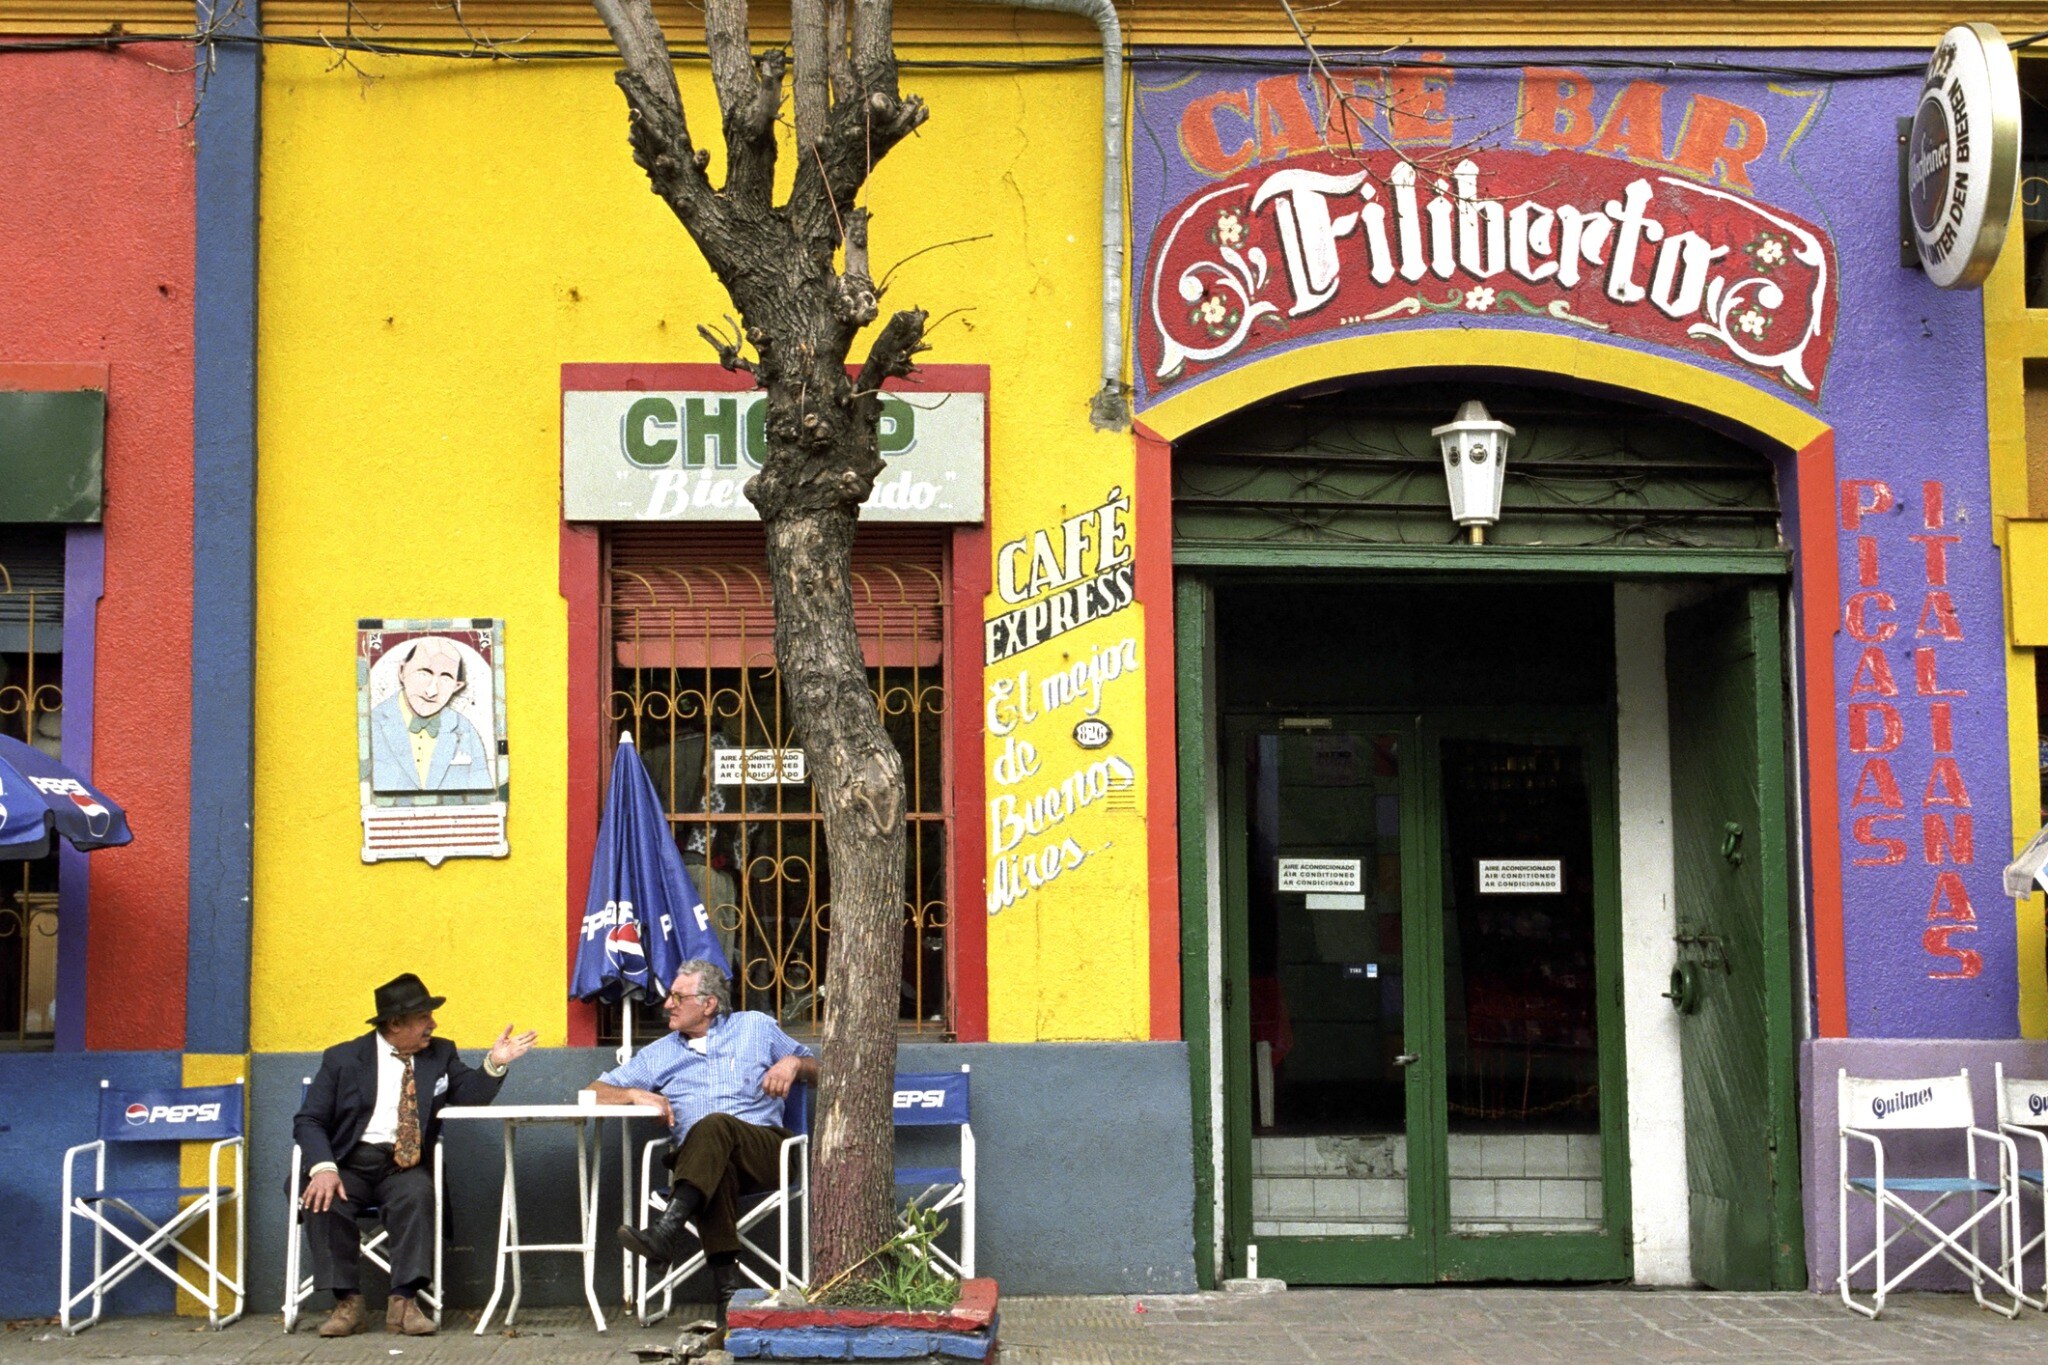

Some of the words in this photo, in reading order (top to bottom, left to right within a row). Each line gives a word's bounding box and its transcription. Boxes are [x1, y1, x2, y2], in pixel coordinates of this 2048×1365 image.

[1178, 52, 1453, 177] CAFÉ
[1516, 66, 1769, 194] BAR
[1947, 77, 1970, 163] BIEREN
[1251, 158, 1729, 319] Filiberto
[1950, 172, 1969, 228] DEN
[620, 397, 917, 470] CHP
[997, 486, 1131, 604] CAFÉ
[986, 564, 1135, 665] EXPRESS
[986, 669, 1038, 737] El
[1040, 637, 1139, 716] mejor
[1840, 479, 1908, 868] PICADAS
[993, 736, 1043, 787] de
[1080, 725, 1104, 741] 826
[1908, 480, 1983, 980] ITALIANAS
[28, 776, 92, 796] PEPSI
[989, 756, 1136, 860] Buenos
[149, 1103, 221, 1122] PEPSI
[892, 1089, 946, 1108] EPSI
[1872, 1086, 1933, 1119] Quilmes
